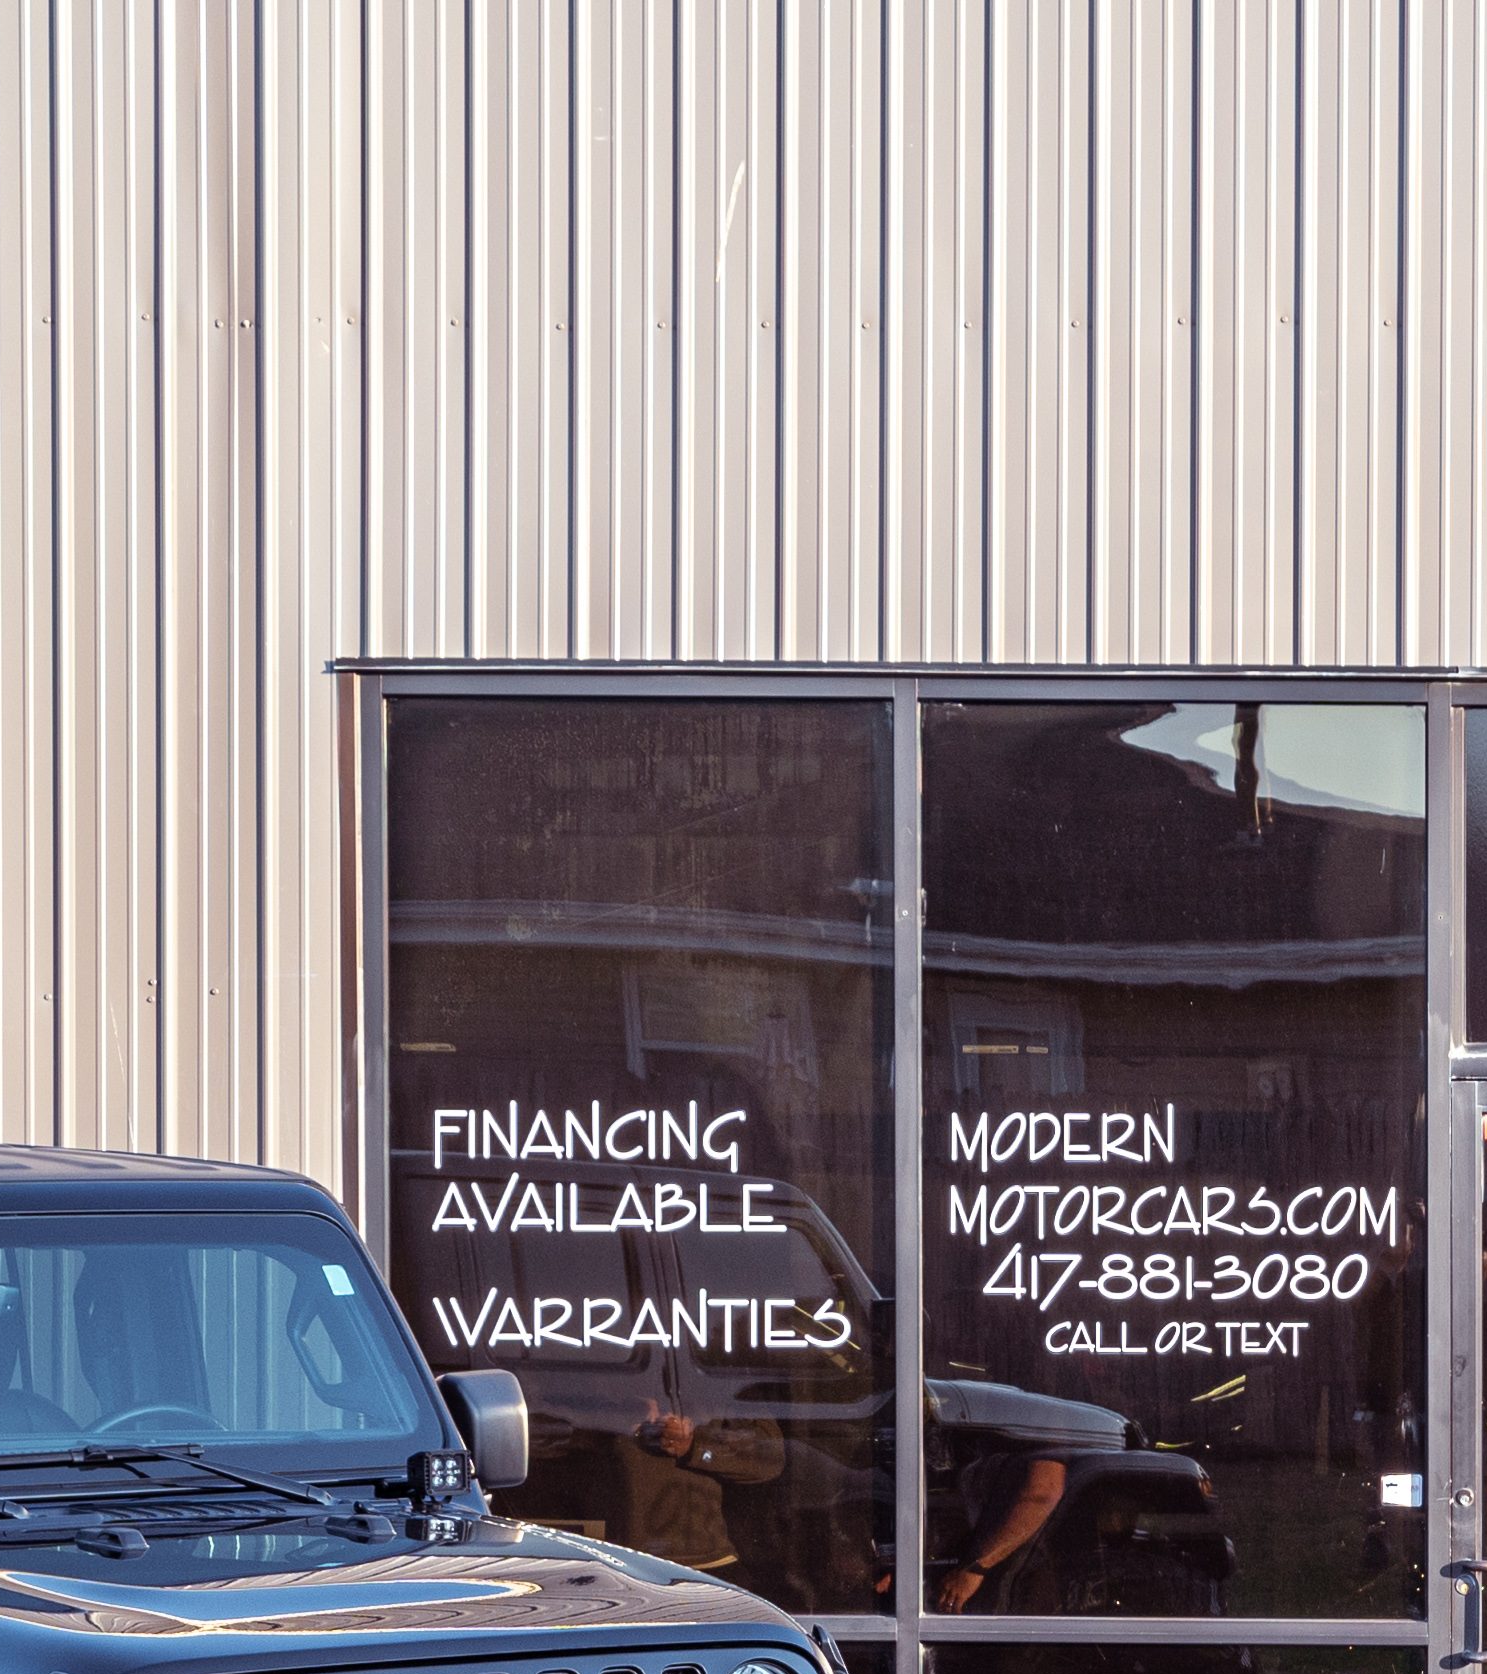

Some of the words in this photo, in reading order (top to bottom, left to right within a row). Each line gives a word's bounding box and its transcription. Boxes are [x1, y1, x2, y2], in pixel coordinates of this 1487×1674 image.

[433, 1099, 748, 1174] FINANCING
[950, 1102, 1175, 1166] MODERN
[430, 1172, 789, 1234] AVAILABLE
[949, 1183, 1397, 1249] MOTORCARS.COM
[979, 1240, 1370, 1312] 417-881-3080
[431, 1285, 852, 1354] WARRANTIES
[1044, 1319, 1149, 1354] CALL
[1153, 1320, 1214, 1355] OR
[1213, 1320, 1310, 1358] TEXT
